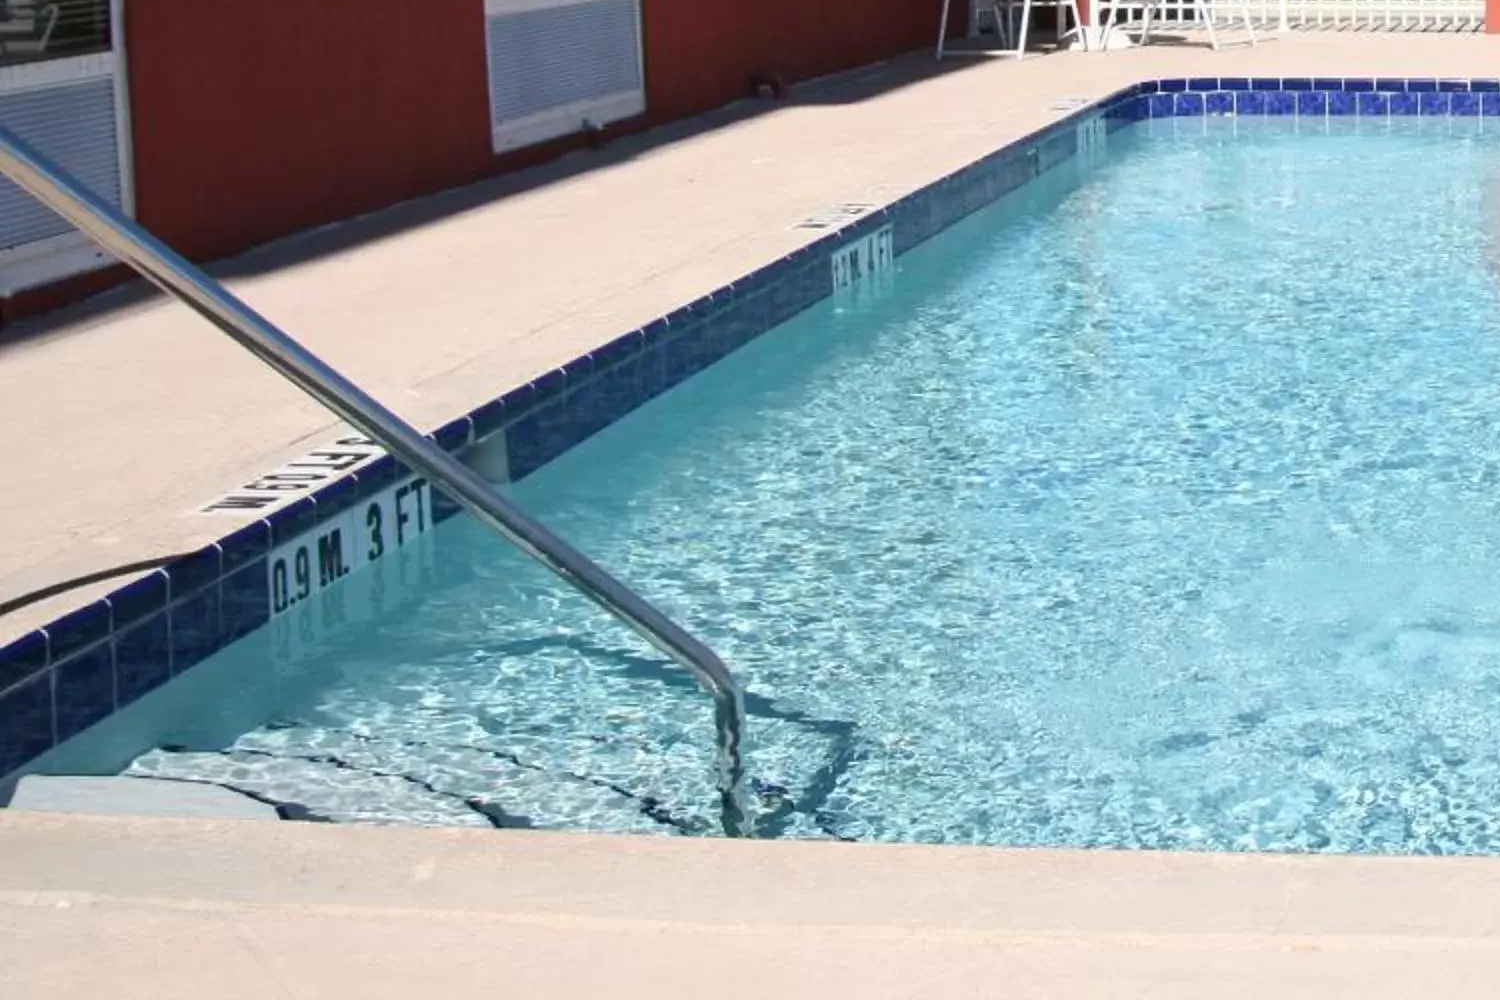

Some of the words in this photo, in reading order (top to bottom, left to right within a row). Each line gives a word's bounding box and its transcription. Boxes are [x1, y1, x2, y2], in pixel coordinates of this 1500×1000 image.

[288, 452, 372, 470] FT
[272, 546, 310, 614] 0.9
[318, 527, 350, 587] M.
[366, 502, 384, 561] 3
[395, 478, 428, 547] FT
